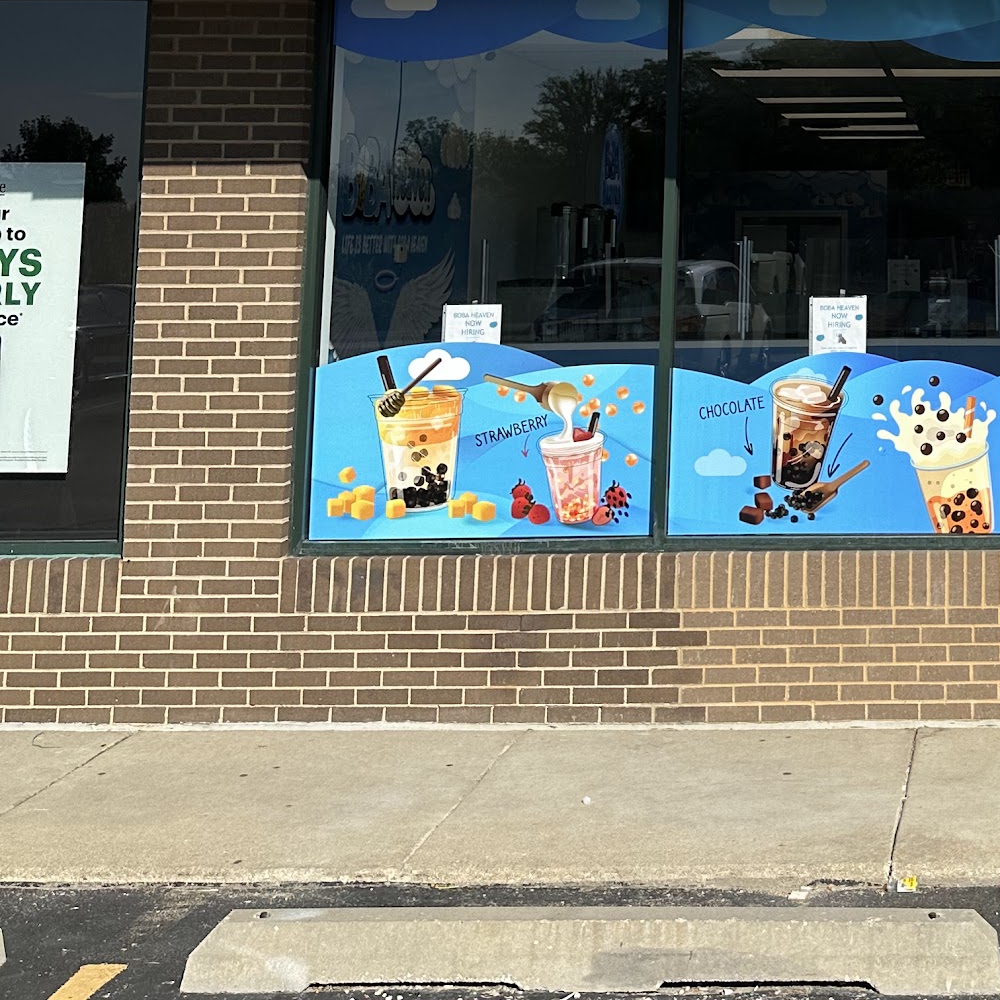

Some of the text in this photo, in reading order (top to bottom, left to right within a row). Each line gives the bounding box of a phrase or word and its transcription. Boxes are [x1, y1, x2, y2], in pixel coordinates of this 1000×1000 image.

[6, 227, 27, 241] to
[464, 319, 482, 327] NOW
[827, 321, 851, 329] HIRING
[461, 328, 485, 336] HIRING
[698, 395, 766, 421] CHOCOLATE
[474, 414, 549, 448] STRAWBERRY
